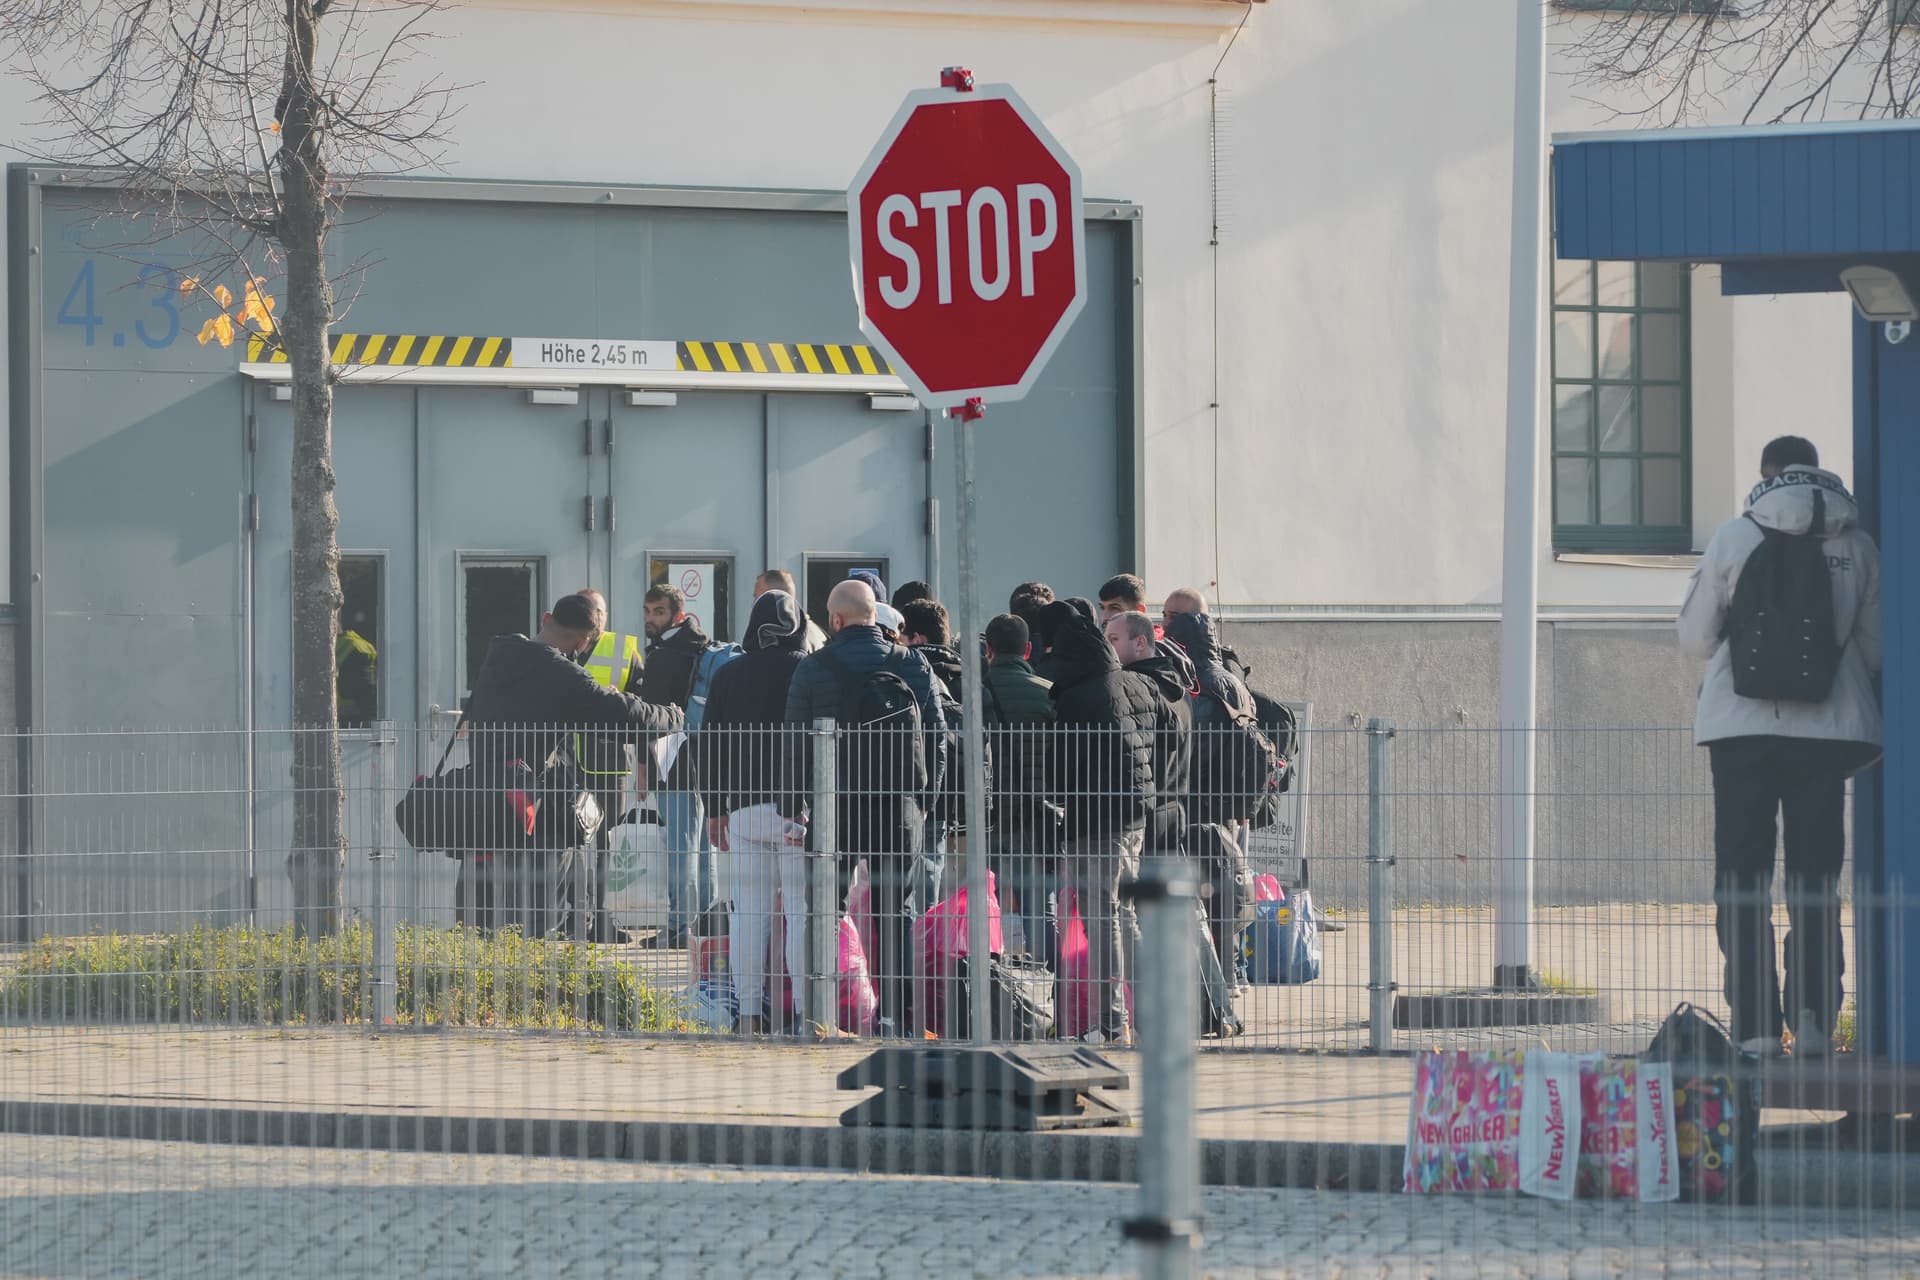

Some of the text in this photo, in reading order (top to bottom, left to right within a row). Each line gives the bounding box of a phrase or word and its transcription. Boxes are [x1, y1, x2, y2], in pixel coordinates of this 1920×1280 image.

[877, 183, 1057, 310] STOP
[57, 259, 181, 349] 4.3
[541, 344, 647, 365] Höhe 2,45 m
[1829, 555, 1851, 570] DE
